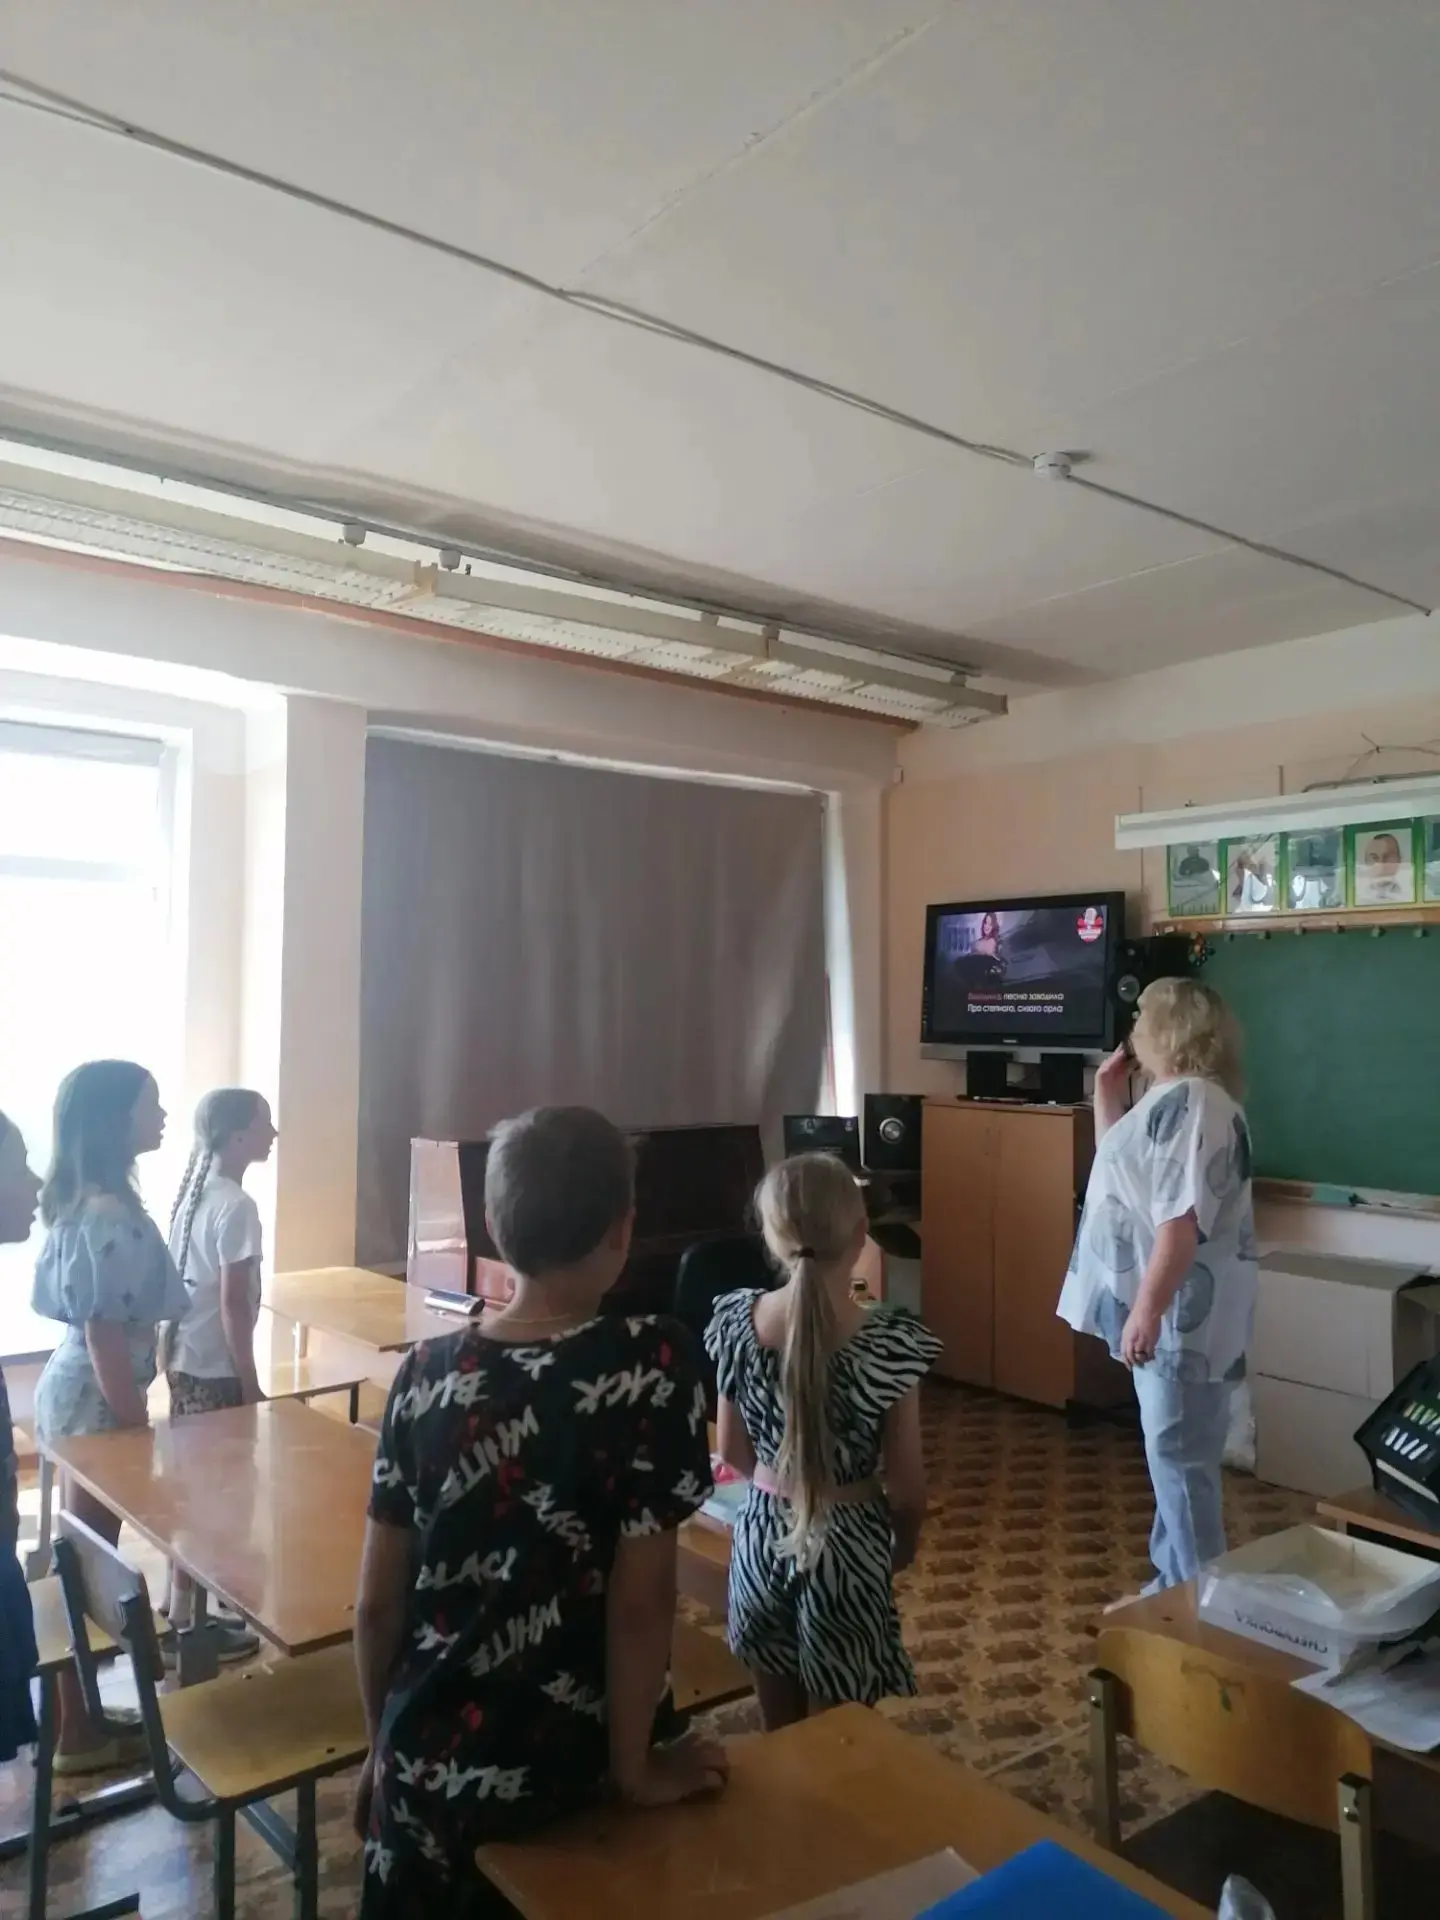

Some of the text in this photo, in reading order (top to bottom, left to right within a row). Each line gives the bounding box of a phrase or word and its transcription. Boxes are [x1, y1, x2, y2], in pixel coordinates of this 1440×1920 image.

[439, 1403, 540, 1509] WHITE
[464, 1595, 562, 1677] WHITE
[394, 1750, 534, 1803] BLACK
